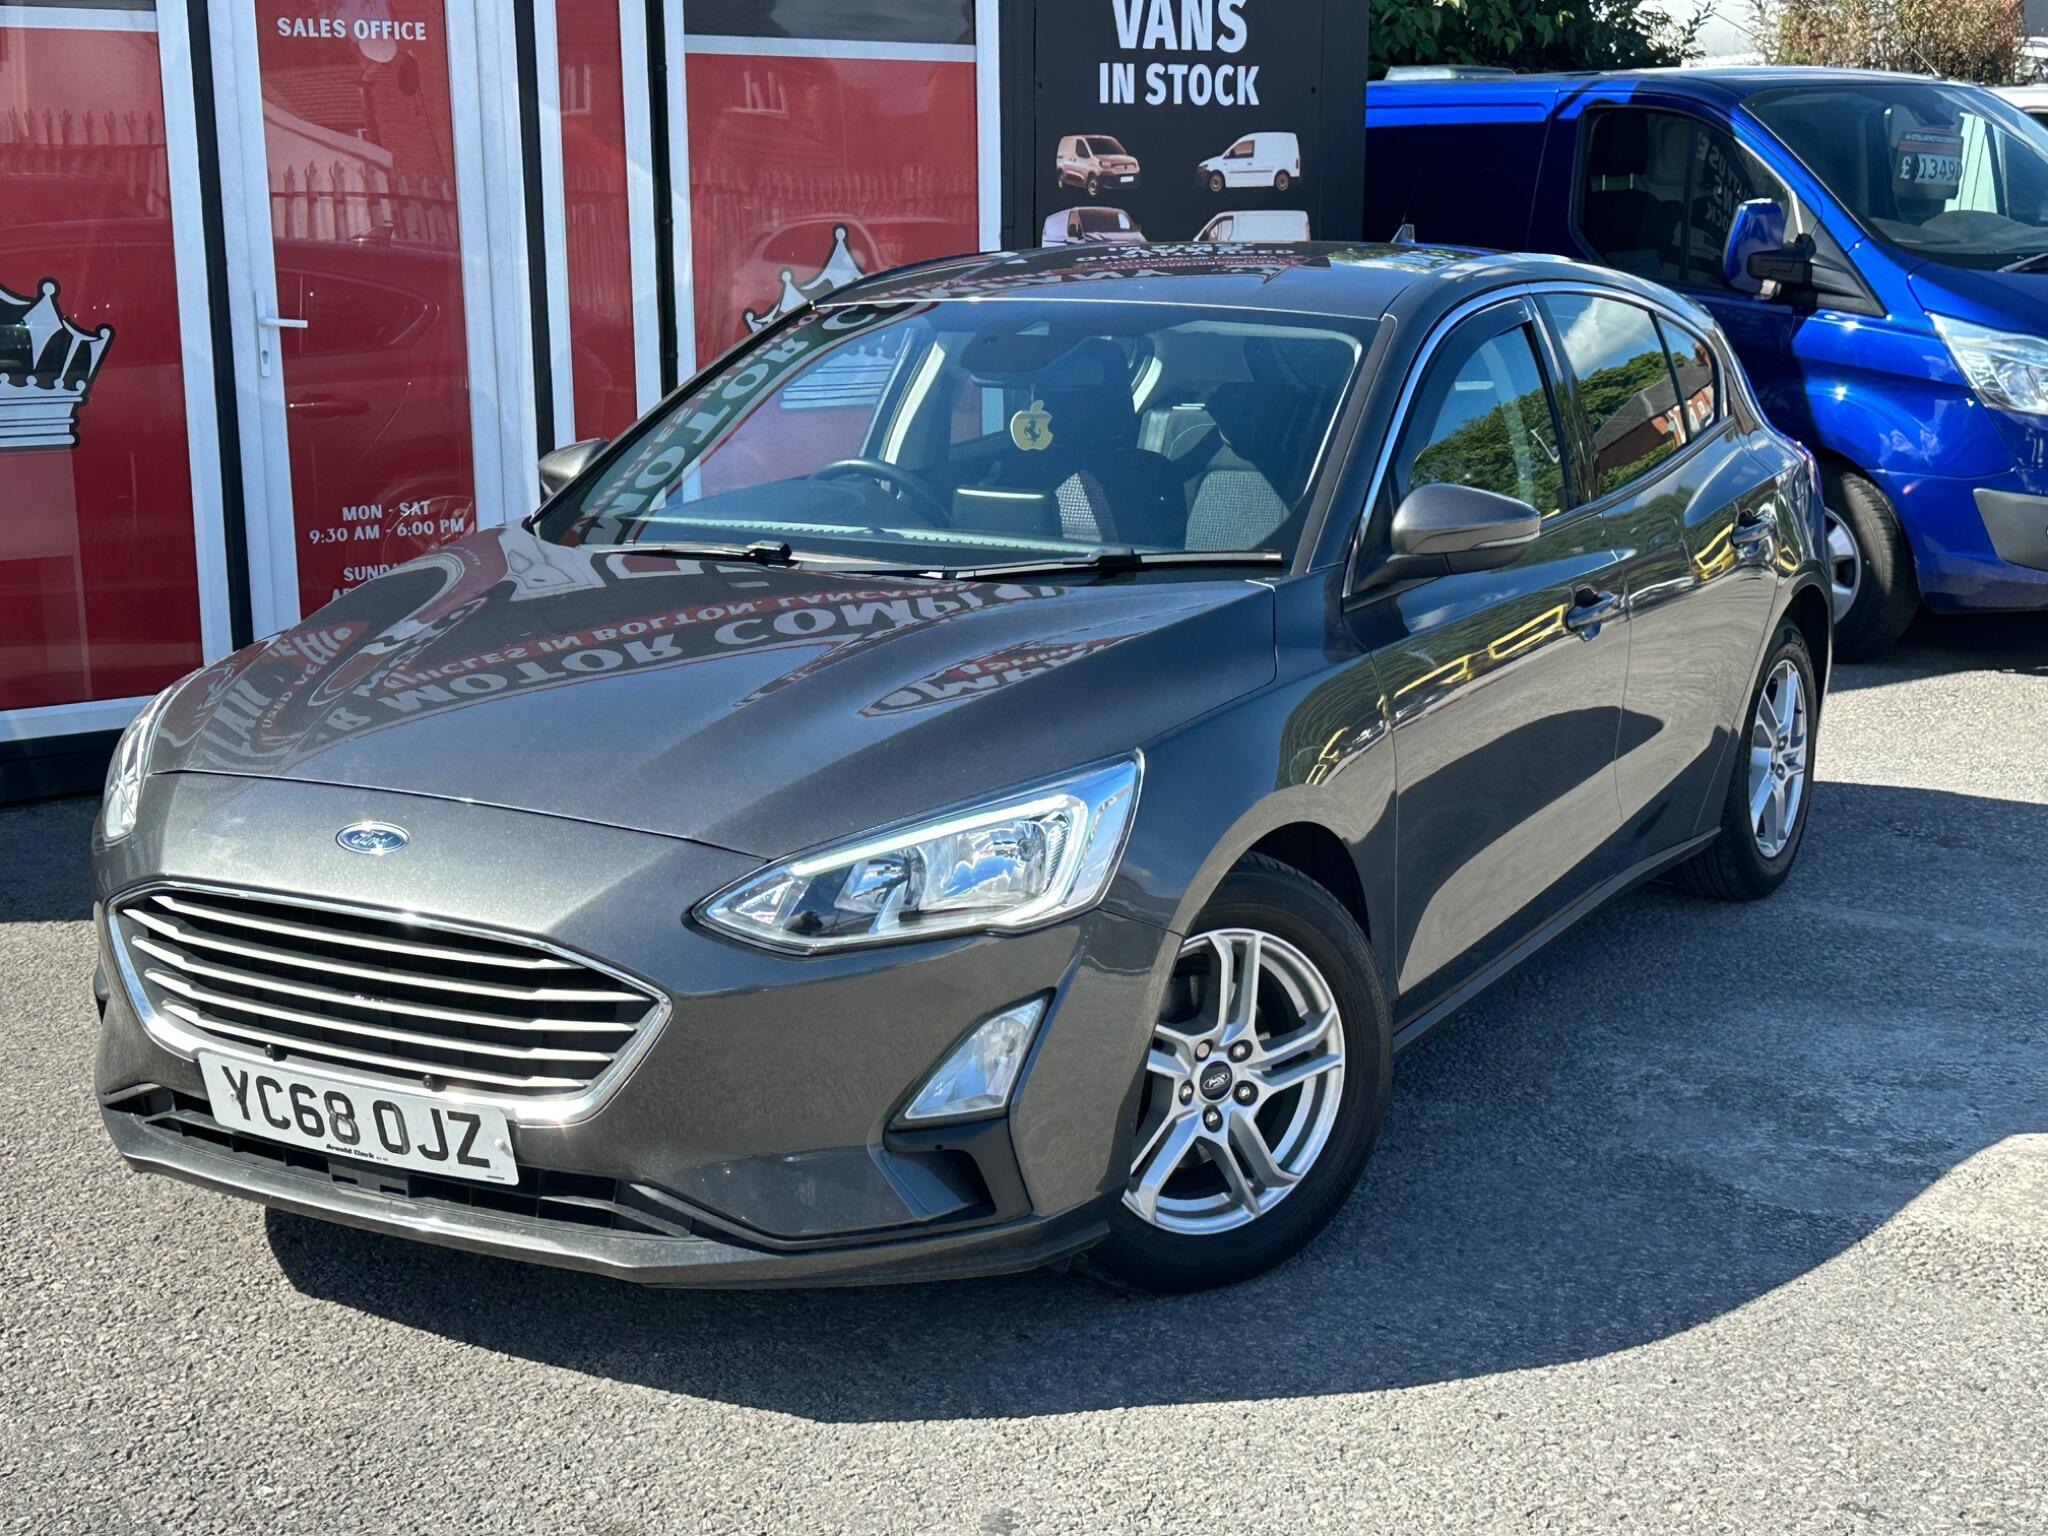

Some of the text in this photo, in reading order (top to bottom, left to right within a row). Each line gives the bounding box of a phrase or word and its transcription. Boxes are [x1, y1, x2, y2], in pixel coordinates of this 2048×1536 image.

[276, 17, 427, 41] SALES OFFICE
[1112, 0, 1248, 53] VANS
[1099, 62, 1260, 106] IN STOCK
[342, 504, 382, 521] MON
[399, 500, 431, 517] SAT
[309, 529, 348, 545] 9:30
[354, 524, 380, 541] AM
[396, 520, 435, 537] 6:00
[439, 518, 465, 534] PM
[343, 563, 400, 582] SUND
[221, 1065, 361, 1146] YC68
